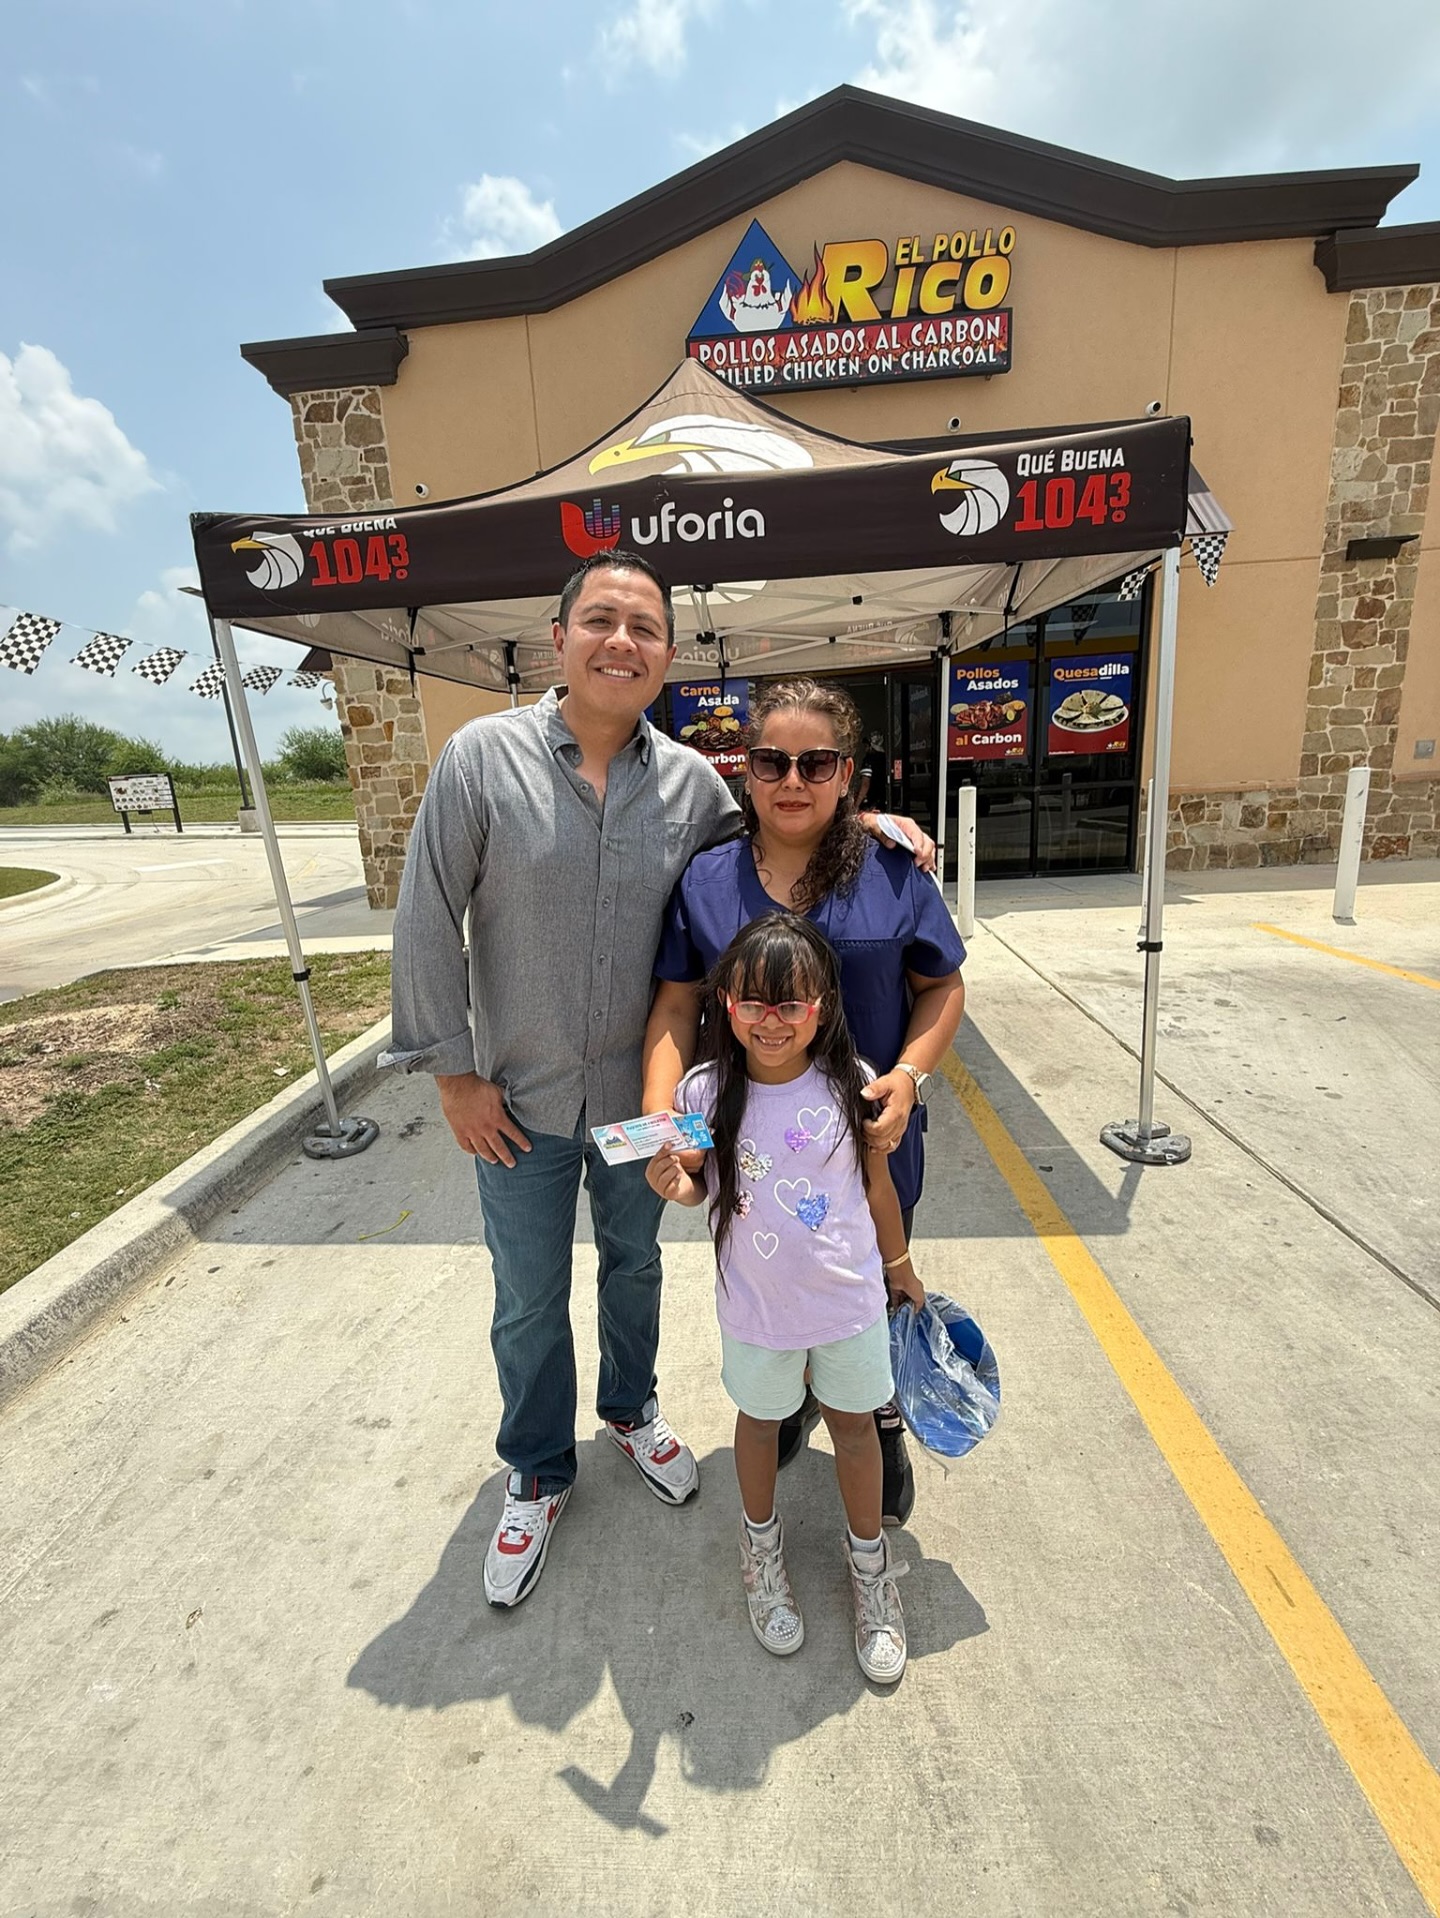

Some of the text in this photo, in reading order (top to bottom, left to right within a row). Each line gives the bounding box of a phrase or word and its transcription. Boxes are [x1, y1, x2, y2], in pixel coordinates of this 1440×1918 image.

[895, 226, 1016, 266] EL POLLO
[823, 239, 1011, 324] RICO
[700, 316, 1001, 366] POLLOS ASADOS AL CARBON
[715, 344, 997, 386] ILLED CHICKEN ON CHARCOAL
[1016, 447, 1125, 477] QUÉ BUENA
[631, 497, 766, 545] uforia
[956, 667, 1000, 680] Pollos
[1053, 663, 1130, 682] Quesadilla
[680, 685, 720, 697] Carne
[967, 678, 1019, 691] Asados
[698, 694, 740, 707] Asada
[955, 733, 1022, 746] al Carbon
[704, 753, 746, 764] arbon
